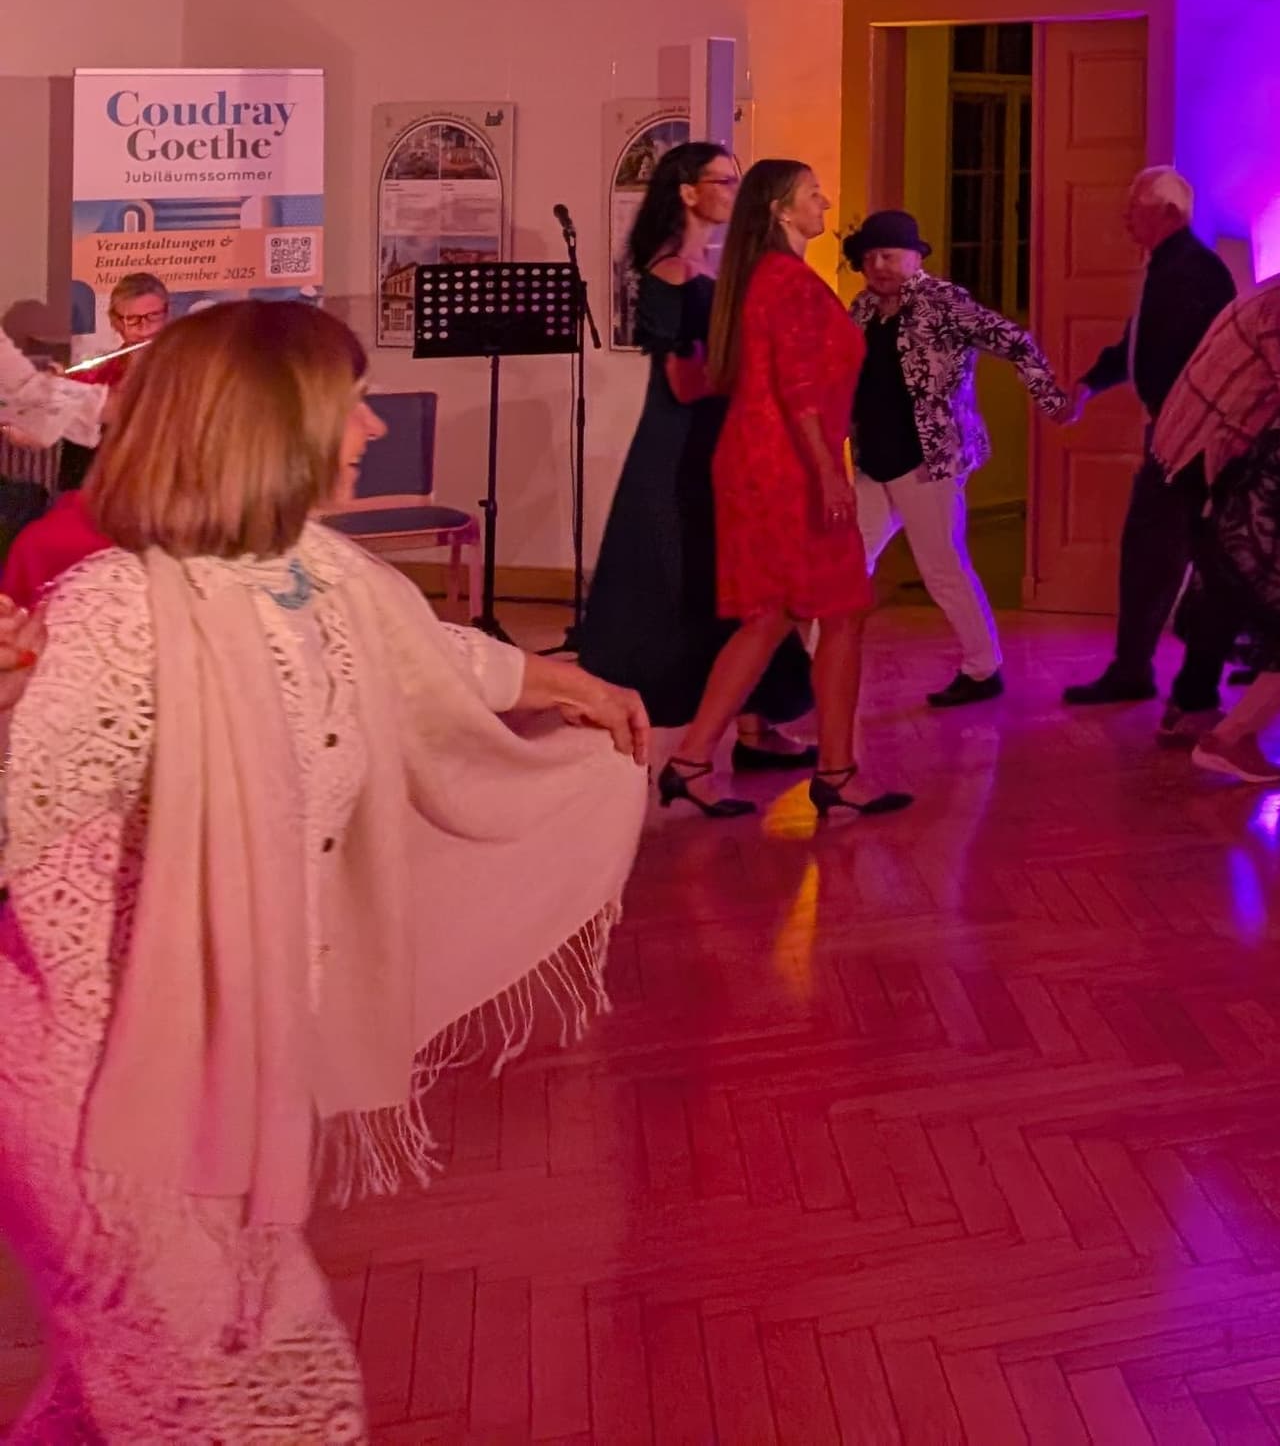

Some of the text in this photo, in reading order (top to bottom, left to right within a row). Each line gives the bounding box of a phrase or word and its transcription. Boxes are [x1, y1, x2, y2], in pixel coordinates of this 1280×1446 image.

[106, 90, 297, 137] Coudray
[127, 128, 272, 162] Goethe
[125, 170, 273, 184] Jubiläumssommer
[96, 235, 234, 252] Veranstaltungen &
[95, 253, 217, 269] Entdeckertouren
[223, 267, 257, 280] 2025
